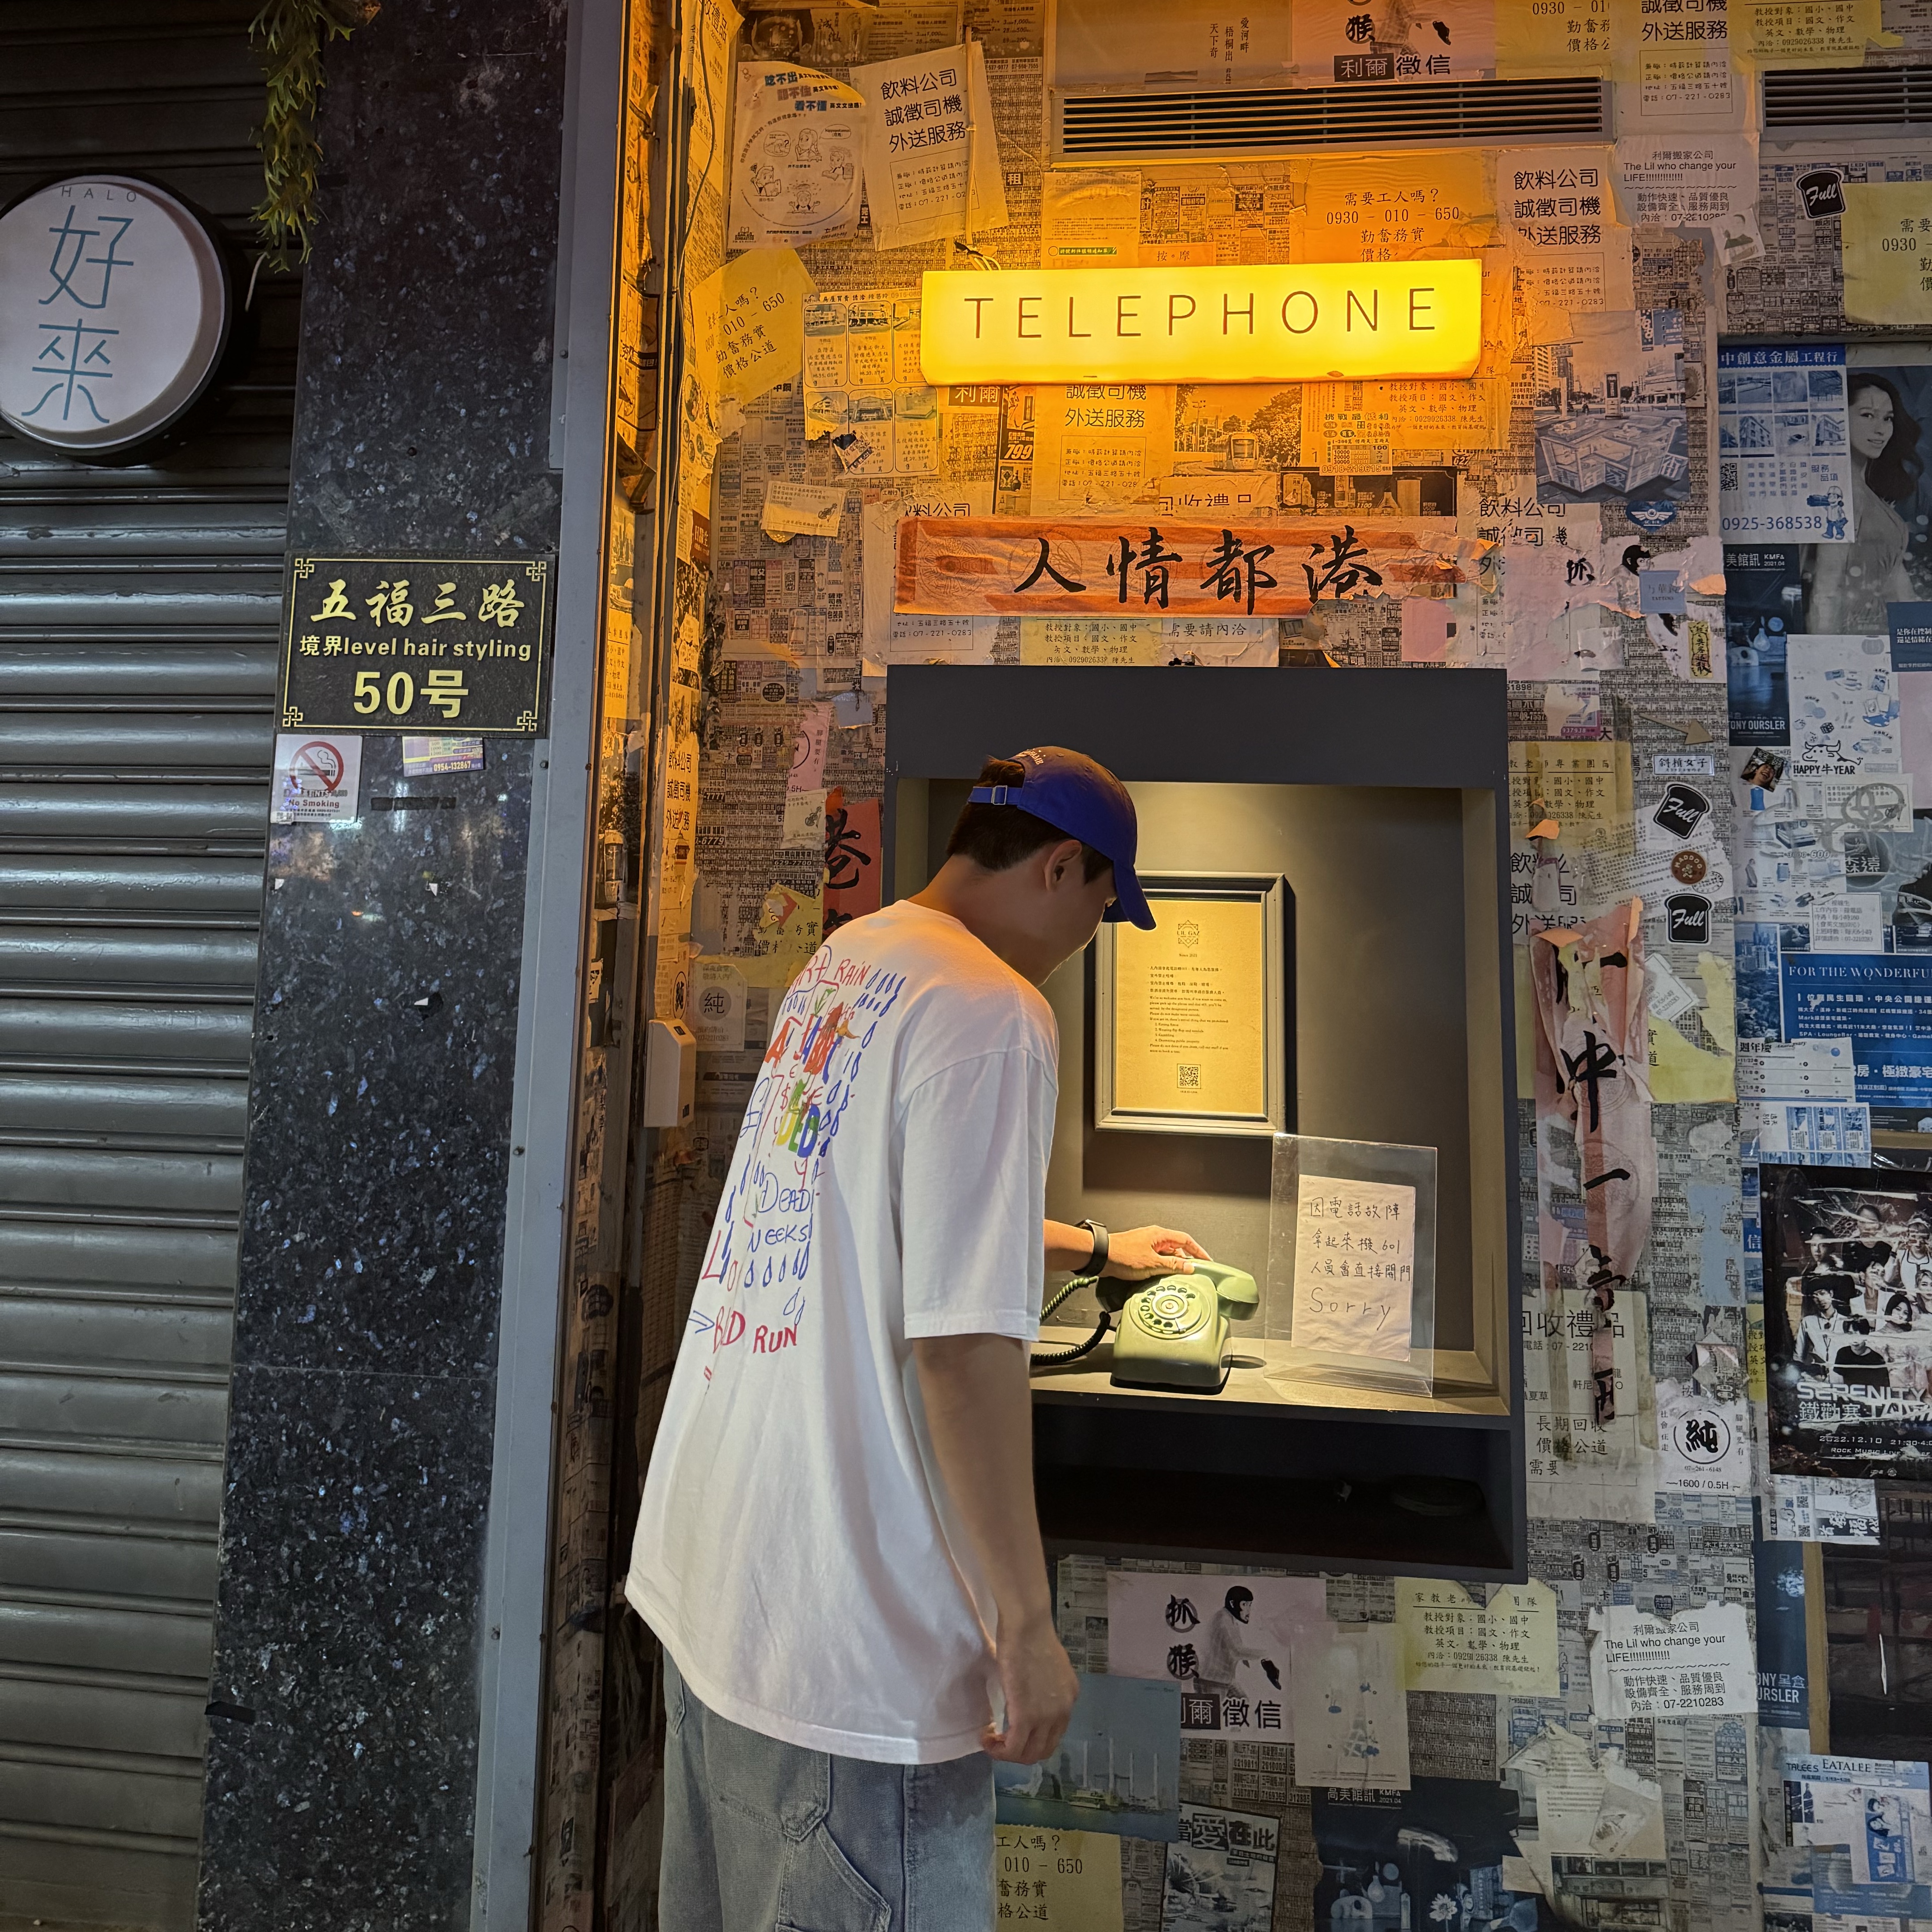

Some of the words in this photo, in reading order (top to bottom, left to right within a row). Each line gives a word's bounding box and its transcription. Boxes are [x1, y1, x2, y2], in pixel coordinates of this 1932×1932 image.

[1533, 1, 1564, 15] 0930
[1240, 17, 1250, 53] 愛河畔
[1347, 14, 1375, 42] 猴
[1642, 21, 1728, 41] 外送服務
[1210, 23, 1218, 58] 天下奇
[1828, 36, 1853, 44] 陳先生
[1341, 54, 1450, 78] 利爾徵信
[881, 68, 957, 100] 飲料公司
[885, 94, 964, 127] 誠徵司機
[889, 121, 966, 153] 外送服務
[1652, 151, 1713, 160] 利爾搬家公司
[1679, 162, 1712, 170] change
[1715, 162, 1736, 170] your
[1514, 168, 1598, 190] 飲料公司
[62, 187, 136, 202] HALO
[1344, 188, 1439, 206] 需要工人嗎？
[1806, 185, 1837, 207] Full
[1327, 212, 1358, 225] 0930
[1385, 209, 1408, 222] 010
[1435, 207, 1459, 221] 650
[1514, 196, 1600, 218] 誠徵司機
[1361, 227, 1424, 244] 勤奮務實
[1517, 224, 1601, 246] 外送服務
[1882, 238, 1917, 252] 0930
[22, 205, 134, 423] 好來
[723, 316, 745, 335] 010
[762, 293, 784, 312] 650
[964, 287, 1434, 339] TELEPHONE
[723, 341, 777, 378] 價格公道
[1065, 408, 1146, 428] 外送服務
[1003, 444, 1033, 459] 799
[1479, 497, 1565, 518] 飲料公司
[1722, 516, 1822, 530] 0925-368538
[1726, 553, 1760, 566] 美館訊
[311, 579, 524, 627] 五福三路
[1168, 623, 1247, 638] 需要請內洽
[300, 636, 396, 656] 境界level
[404, 639, 447, 656] hair
[453, 639, 531, 661] styling
[354, 670, 468, 718] 50号
[1748, 721, 1785, 730] OURSLER
[434, 761, 471, 771] 0954-132867
[1659, 758, 1708, 768] 斜槓女子
[1794, 765, 1820, 774] HAPPY
[1822, 765, 1833, 774] 牛
[1833, 766, 1855, 774] YEAR
[303, 800, 339, 808] Smoking
[1669, 798, 1698, 823] Full
[1672, 910, 1704, 929] Full
[1789, 966, 1816, 976] FOR
[1819, 967, 1847, 976] THE
[704, 993, 724, 1014] 純
[758, 1172, 811, 1213] DEAD
[1310, 1196, 1400, 1220] 因電話故障
[1310, 1260, 1411, 1282] 人員會直接開門
[1309, 1287, 1391, 1331] Sorry
[753, 1325, 797, 1353] RUN
[1797, 1382, 1927, 1403] SERENITY
[1536, 1416, 1607, 1432] 長期回收
[1536, 1437, 1608, 1454] 價格公道
[1686, 1420, 1718, 1453] 純
[1530, 1460, 1559, 1475] 需要
[1604, 1640, 1623, 1649] The
[1627, 1639, 1637, 1648] Lil
[1641, 1638, 1660, 1647] who
[1665, 1637, 1700, 1646] change
[1704, 1636, 1725, 1645] your
[1823, 1759, 1871, 1772] EATALEE
[1005, 1857, 1030, 1873] 010
[1057, 1858, 1083, 1874] 650
[997, 1877, 1047, 1898] 奮務實
[997, 1903, 1049, 1921] 格公道
